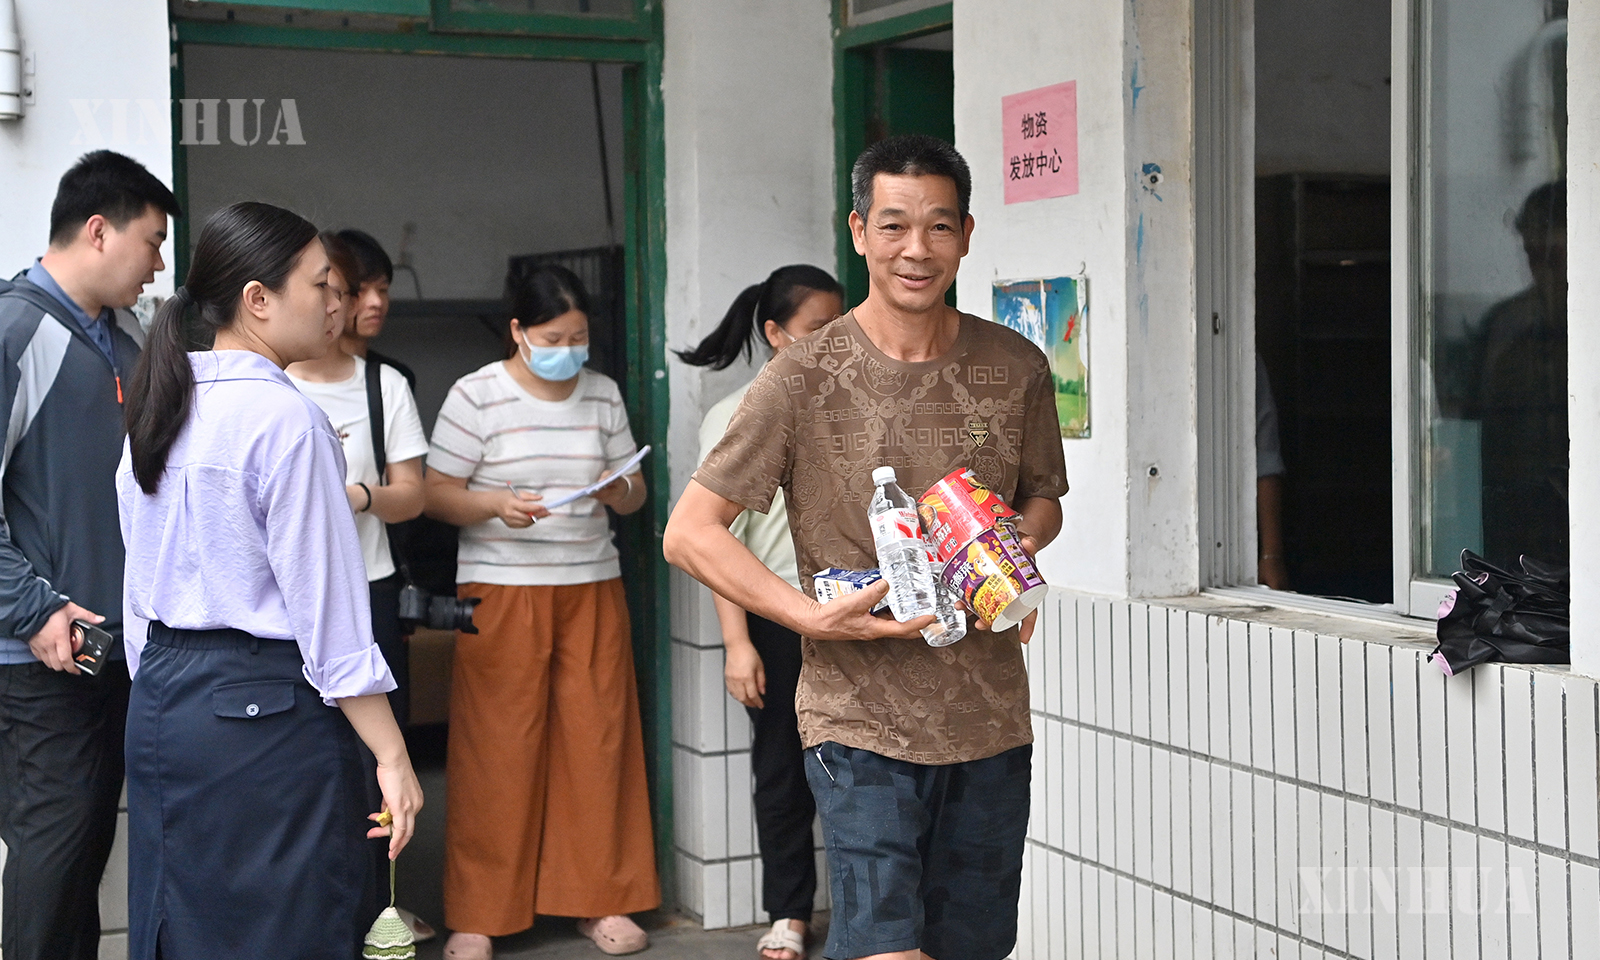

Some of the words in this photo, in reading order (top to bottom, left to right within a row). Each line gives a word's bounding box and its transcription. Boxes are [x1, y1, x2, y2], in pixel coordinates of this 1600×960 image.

[1021, 110, 1048, 140] 物资
[1009, 147, 1063, 181] 发放中心
